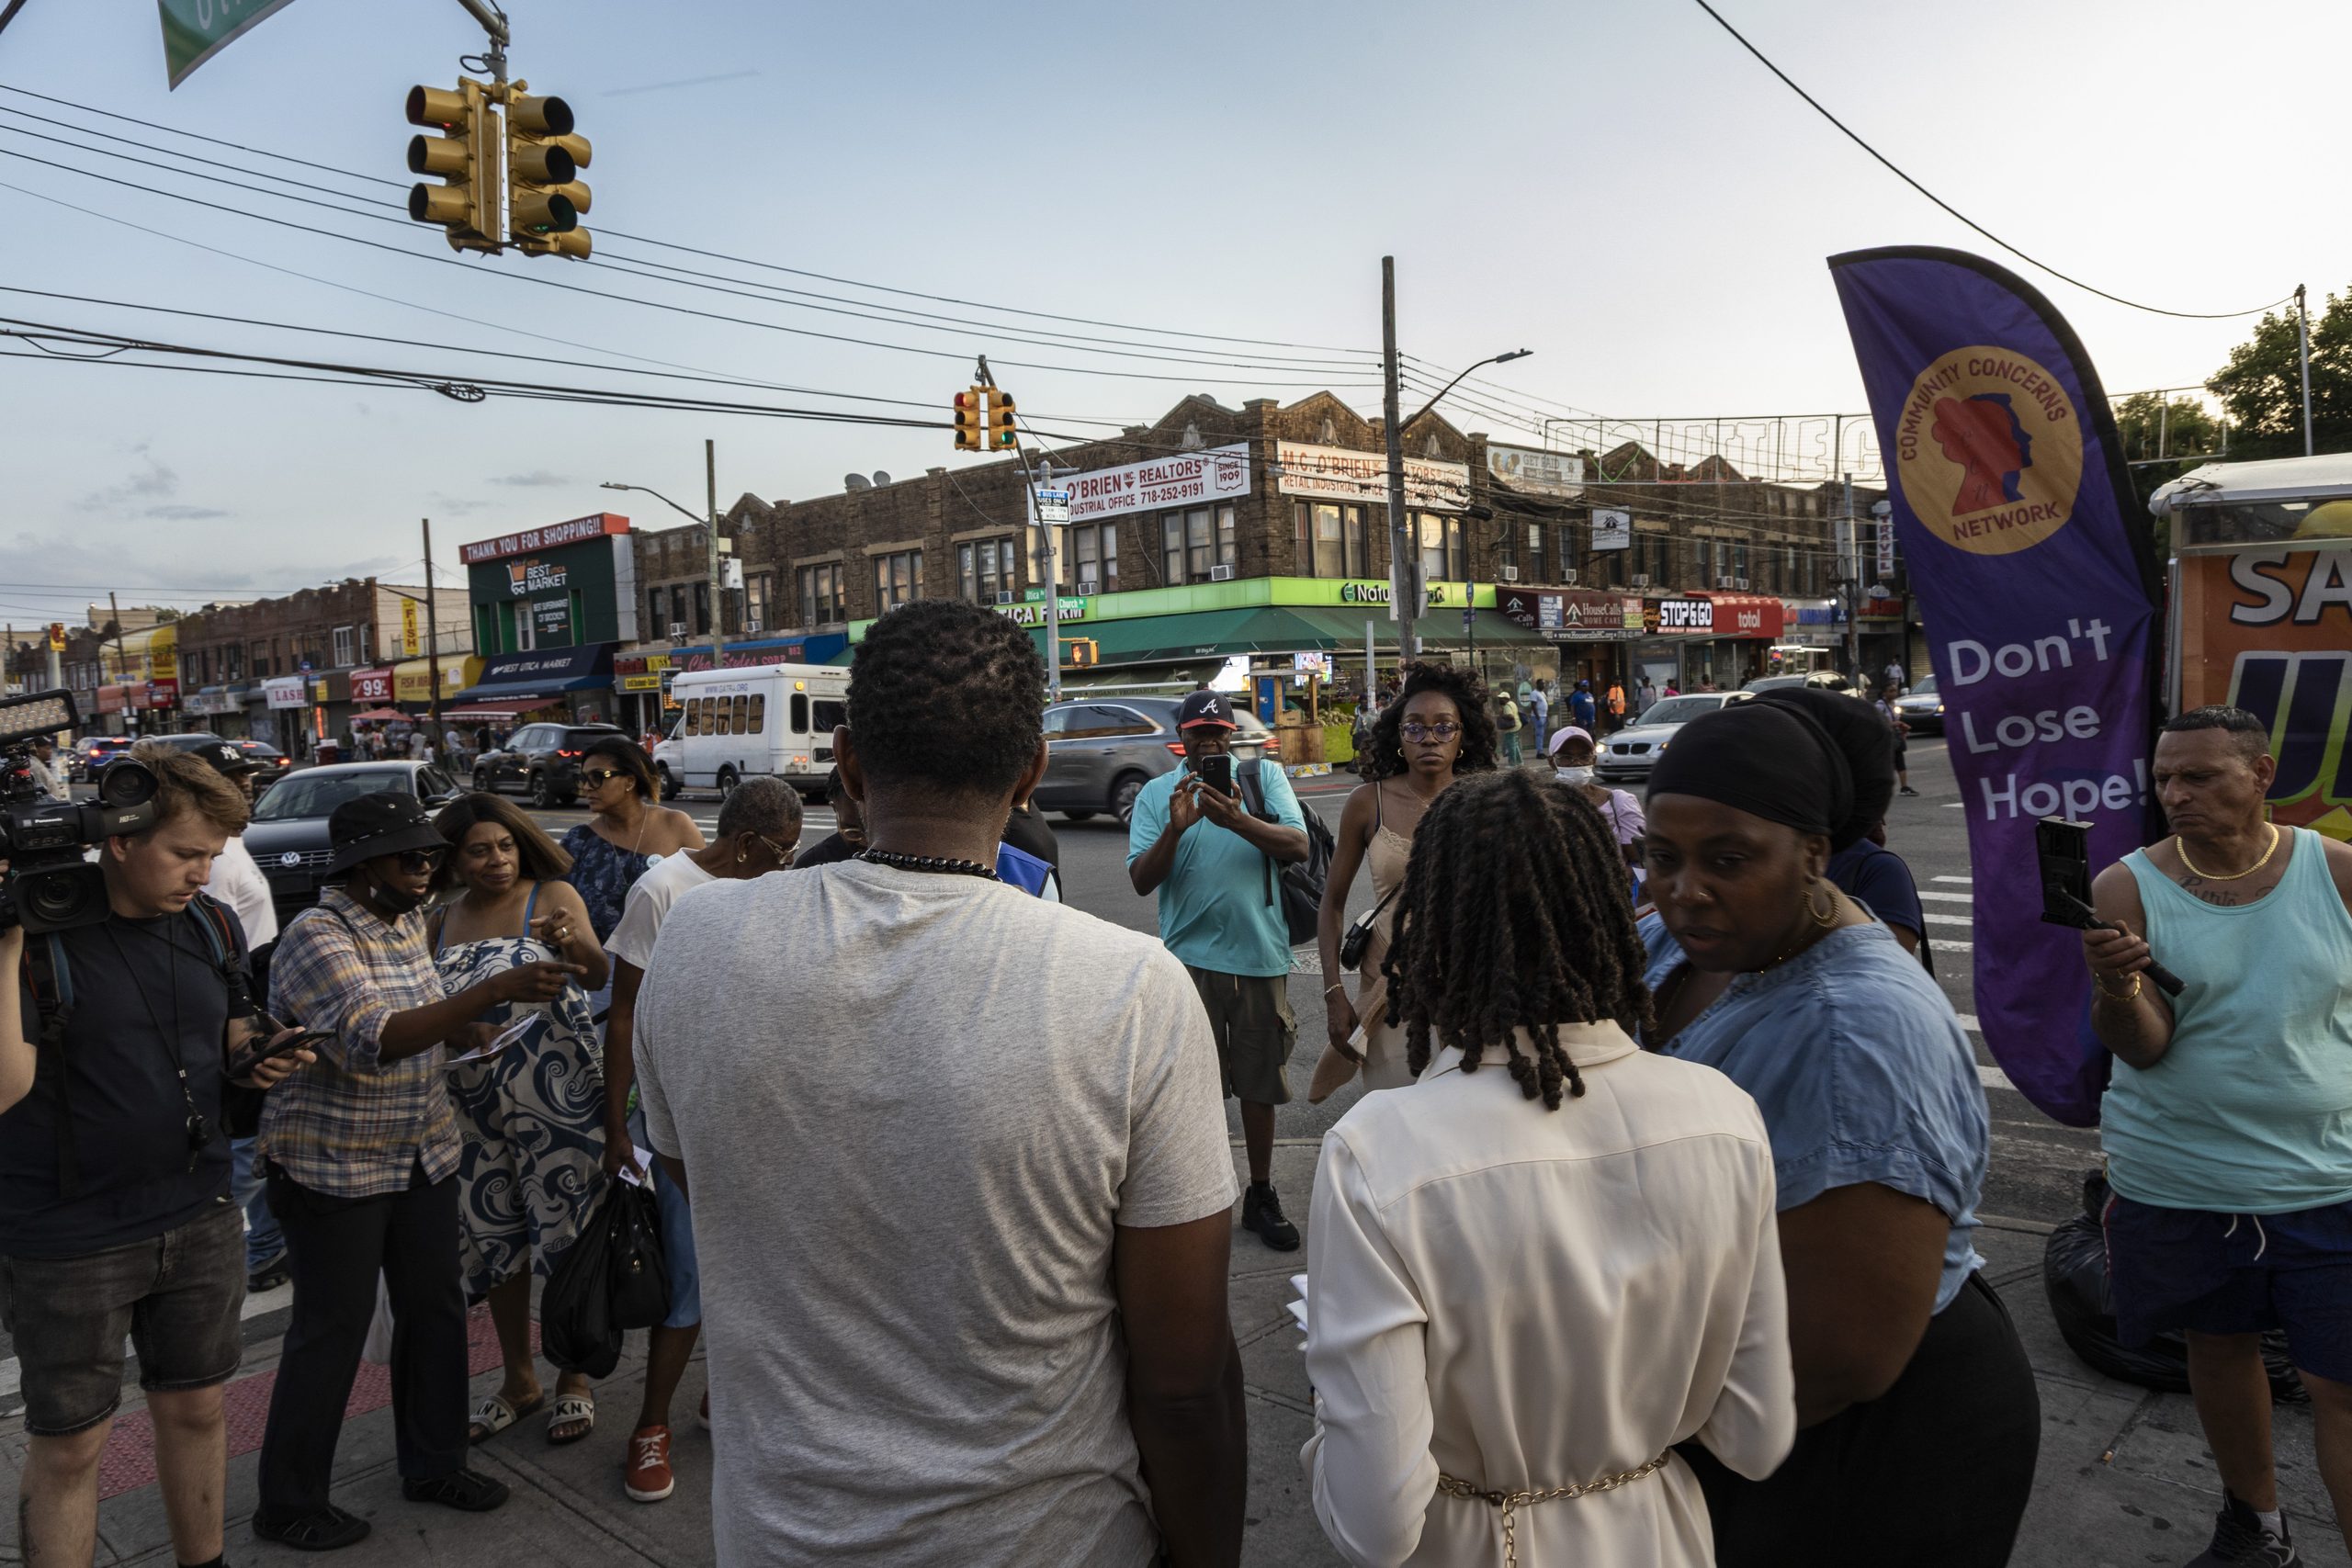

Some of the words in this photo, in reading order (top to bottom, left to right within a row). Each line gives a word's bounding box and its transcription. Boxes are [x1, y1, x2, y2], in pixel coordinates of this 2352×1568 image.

[1900, 362, 1961, 461] COMMUNITY
[1968, 358, 2066, 423] CONCERNS
[1218, 461, 1238, 472] SINCE
[1317, 454, 1370, 478] O'BRIEN
[1522, 454, 1540, 467] GET
[1219, 470, 1239, 482] 1909
[1284, 474, 1310, 489] RETAIL
[1313, 477, 1356, 493] INDUSTRIAL
[1067, 474, 1121, 502] O'BRIEN
[1069, 501, 1106, 516] DUSTRIAL
[1108, 494, 1136, 510] OFFICE
[1141, 481, 1204, 504] 718-252-9191
[1952, 502, 2061, 541] NETWORK
[467, 540, 497, 560] THANK
[499, 537, 518, 553] YOU
[521, 532, 541, 549] FOR
[543, 517, 601, 545] SHOPPING!!
[1879, 514, 1891, 571] TRAVEL
[526, 564, 551, 580] BEST
[527, 573, 568, 592] MARKET
[1026, 591, 1040, 602] Utica
[1357, 584, 1390, 602] Natu
[1058, 598, 1078, 609] Church
[1583, 603, 1622, 616] HouseCalls
[997, 606, 1035, 624] TICA
[1040, 604, 1084, 623] FRM
[1584, 616, 1603, 625] HOME
[1605, 616, 1622, 626] CARE
[1660, 602, 1689, 626] STOP
[1697, 602, 1713, 626] GO
[1737, 609, 1760, 628] total
[405, 609, 416, 648] FISH
[1948, 618, 2111, 686] Don't
[540, 658, 572, 670] MARKET
[276, 689, 304, 702] LASH
[1962, 705, 2101, 754] Lose
[1979, 759, 2148, 823] Hope!
[556, 1402, 594, 1416] KNY
